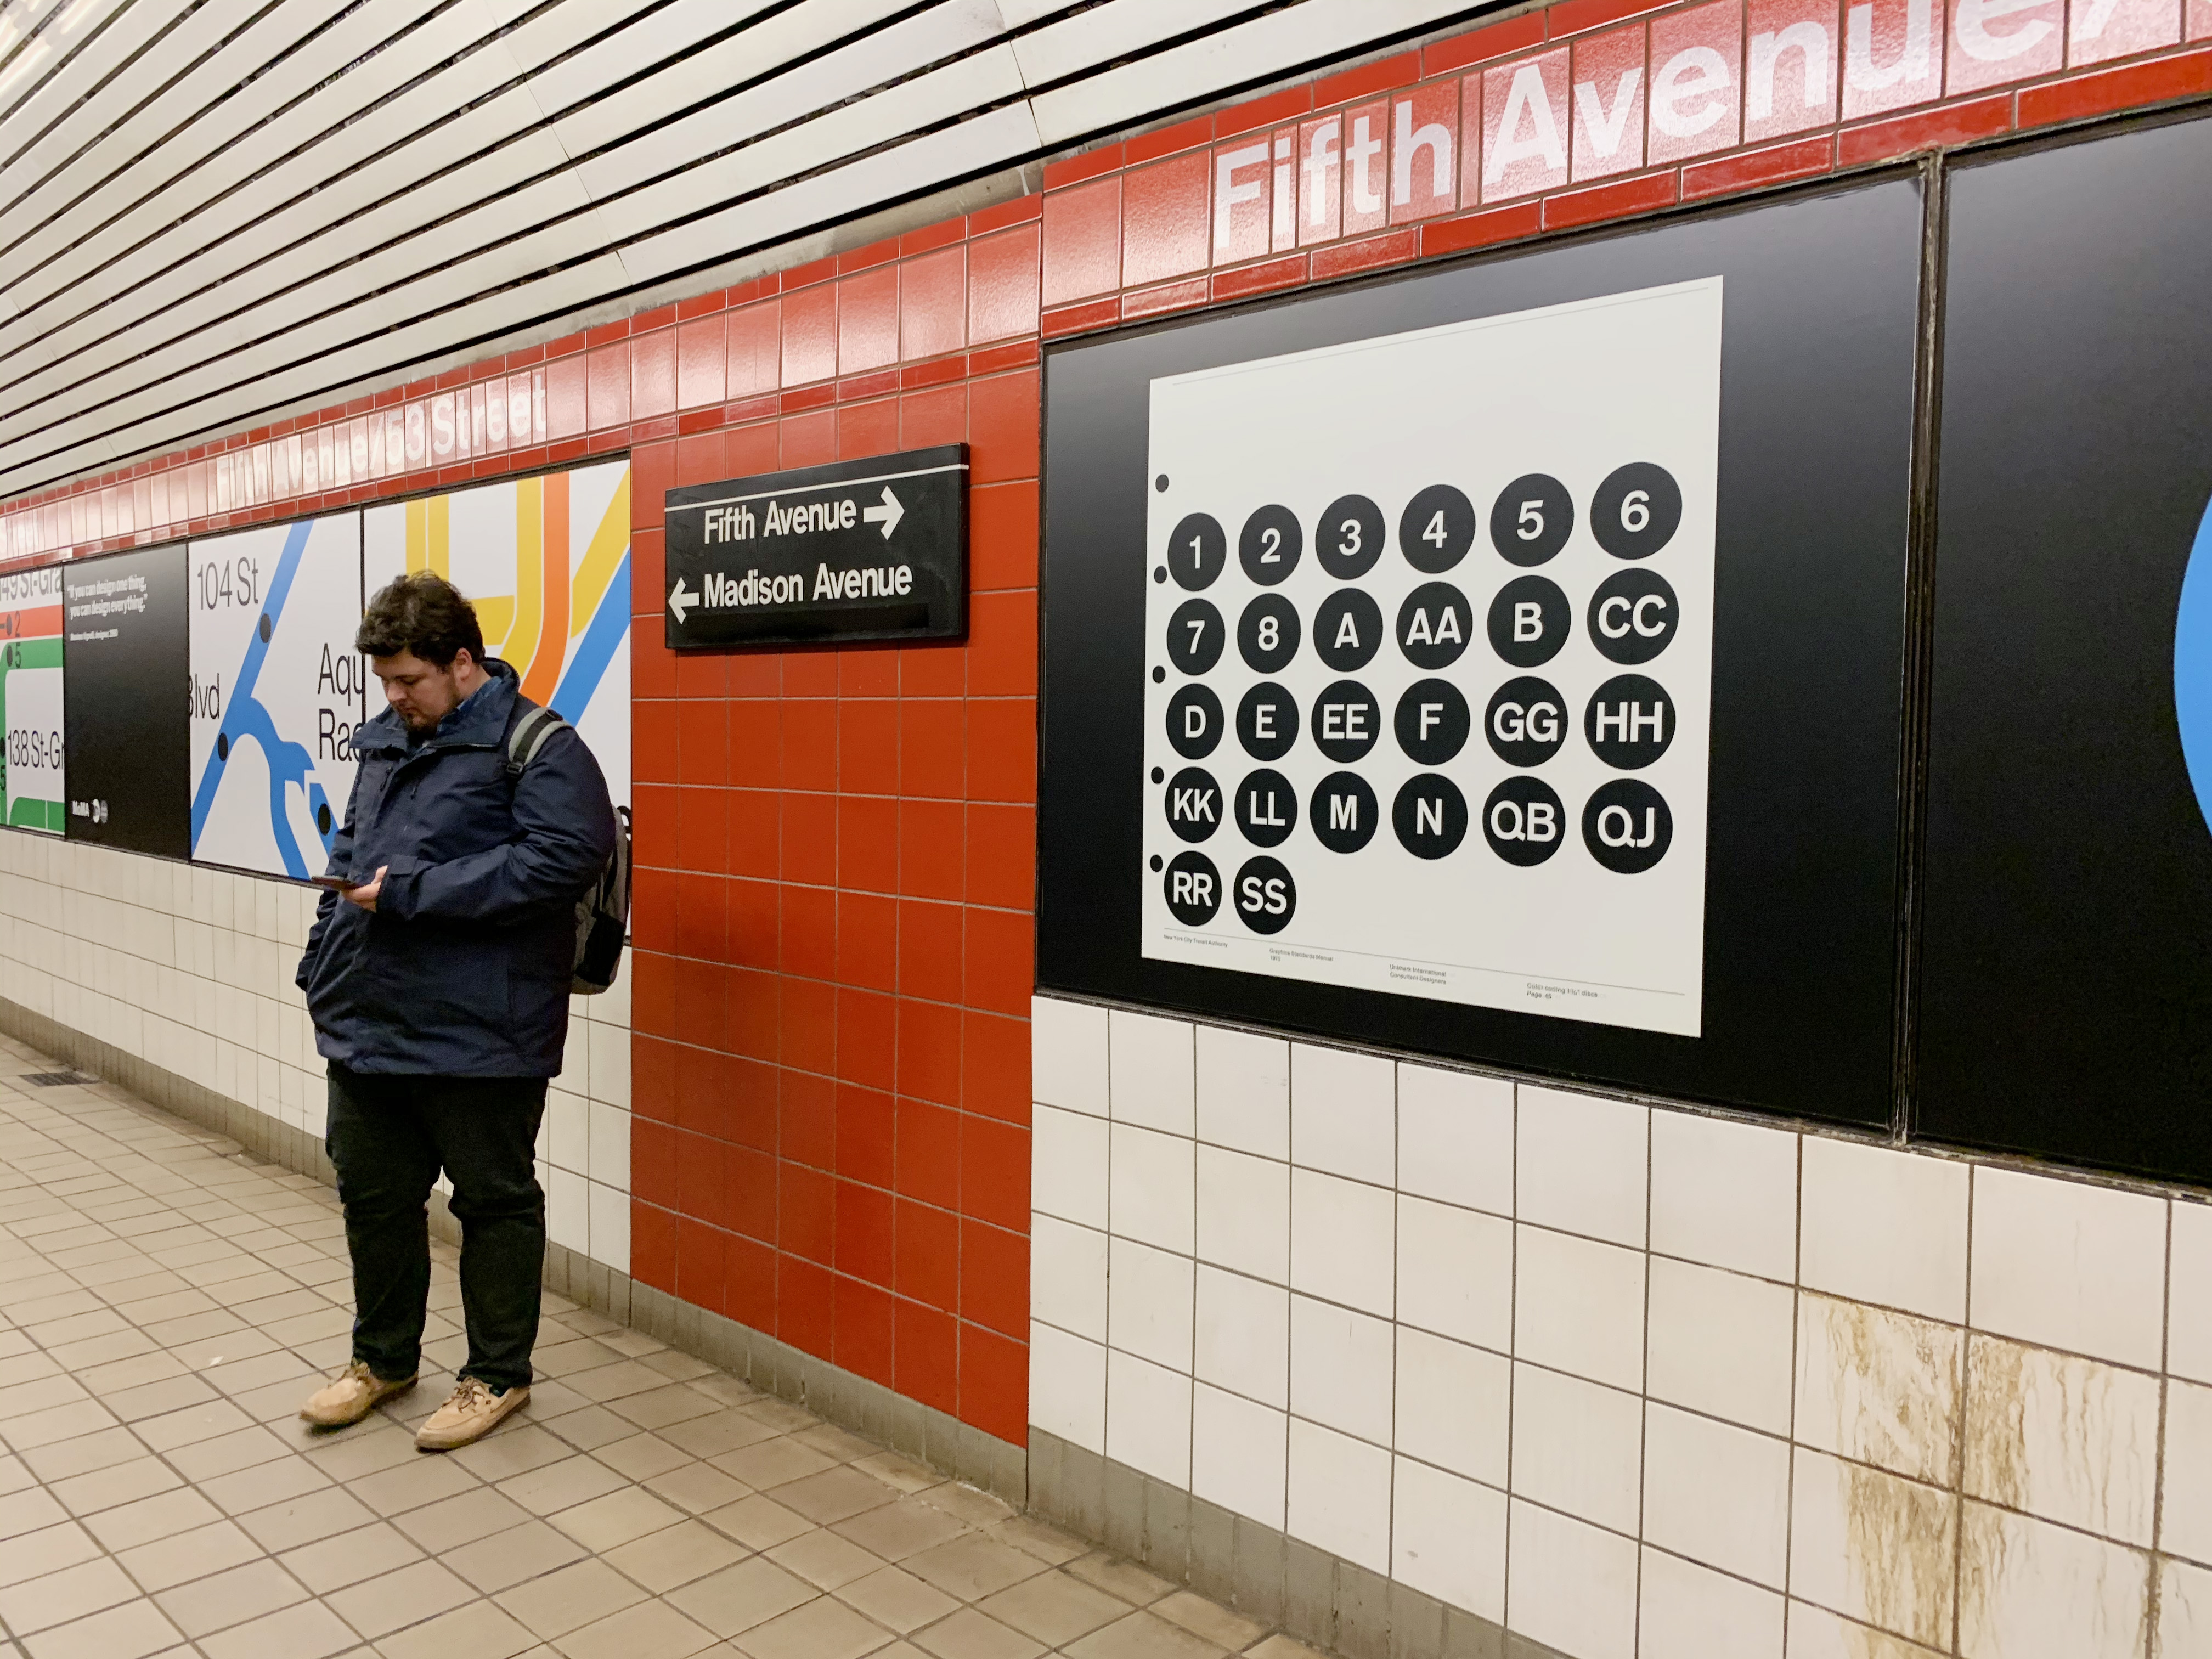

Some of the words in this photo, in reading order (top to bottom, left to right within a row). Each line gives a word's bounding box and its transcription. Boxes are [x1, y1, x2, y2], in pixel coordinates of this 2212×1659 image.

[1216, 100, 1451, 249] Fifth
[218, 445, 267, 504] Fifth
[273, 404, 425, 492] Avenue/53
[433, 375, 546, 455] Street
[704, 504, 755, 544] Fifth
[764, 499, 856, 538] Avenue
[1189, 535, 1201, 569] 1
[1260, 528, 1281, 563] 2
[1339, 518, 1362, 556] 3
[1422, 510, 1447, 549] 4
[1517, 499, 1544, 540] 5
[1620, 490, 1650, 532] 6
[197, 560, 233, 610] 104
[237, 557, 258, 606] St
[704, 569, 804, 608] Madison
[813, 562, 912, 601] Avenue
[15, 611, 21, 638] 2
[1187, 620, 1205, 654] 7
[1258, 616, 1279, 651] 8
[1334, 612, 1359, 648] A
[1406, 606, 1462, 646] AA
[1514, 602, 1543, 642] B
[1598, 594, 1667, 639] CC
[15, 642, 21, 669] 5
[1185, 705, 1206, 738] D
[1256, 704, 1277, 738] E
[1323, 703, 1368, 740] EE
[1420, 703, 1443, 741] F
[1493, 701, 1558, 742] GG
[1596, 701, 1663, 743] HH
[8, 730, 29, 767] 138
[1173, 787, 1215, 823] KK
[1250, 790, 1286, 826] LL
[1330, 794, 1357, 831] M
[1417, 798, 1442, 836] N
[1491, 800, 1556, 842] QB
[1597, 805, 1655, 848] QJ
[1173, 871, 1213, 907] RR
[1242, 876, 1287, 915] SS
[1389, 963, 1411, 972] Unimark
[1413, 967, 1446, 977] International
[1390, 972, 1418, 980] Consultant
[1419, 975, 1446, 985] Designers
[1544, 985, 1565, 995] coding
[1527, 990, 1542, 998] Page
